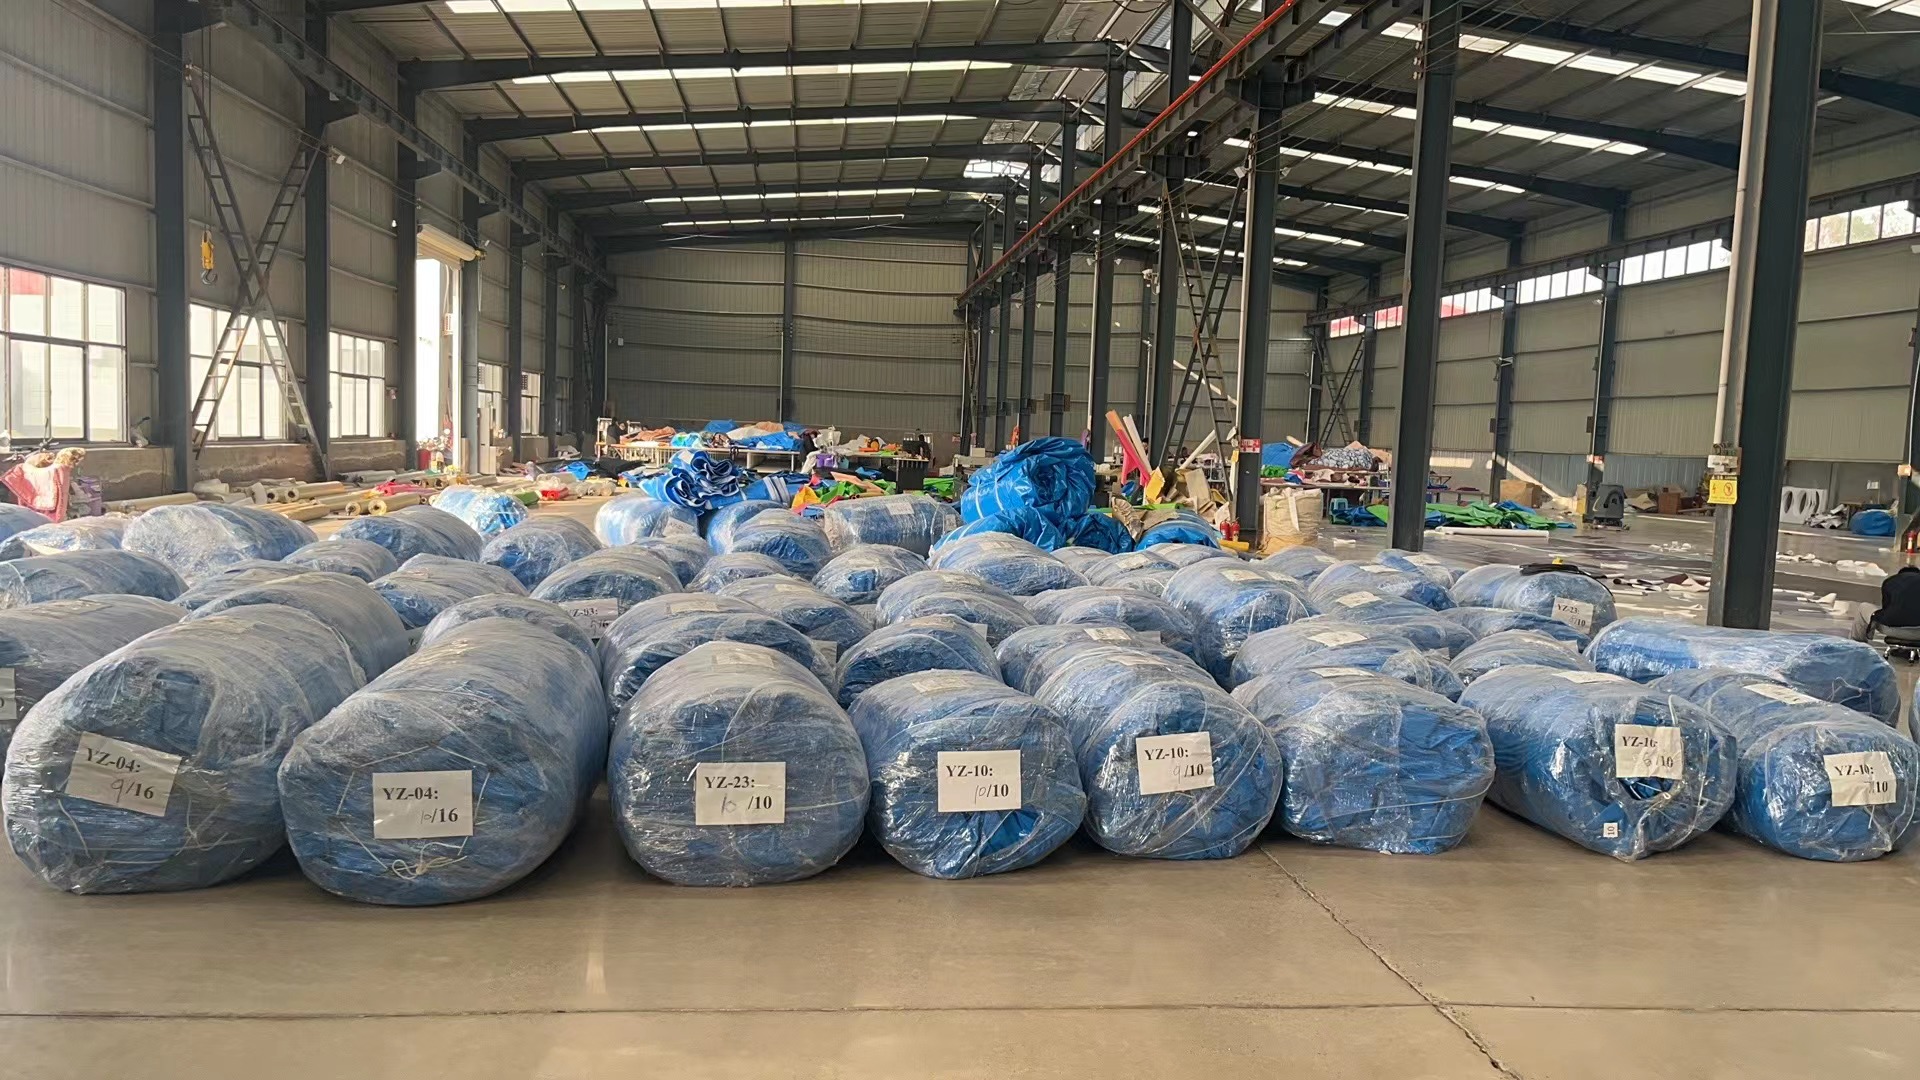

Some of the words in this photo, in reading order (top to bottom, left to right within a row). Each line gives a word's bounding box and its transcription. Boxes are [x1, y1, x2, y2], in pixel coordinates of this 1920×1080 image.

[87, 747, 141, 773] YZ-04:
[1144, 746, 1189, 761] YZ-10:
[946, 764, 993, 777] YZ-10:
[704, 775, 755, 789] YZ-23:
[110, 778, 155, 804] 9/16
[383, 786, 439, 801] YZ-04:
